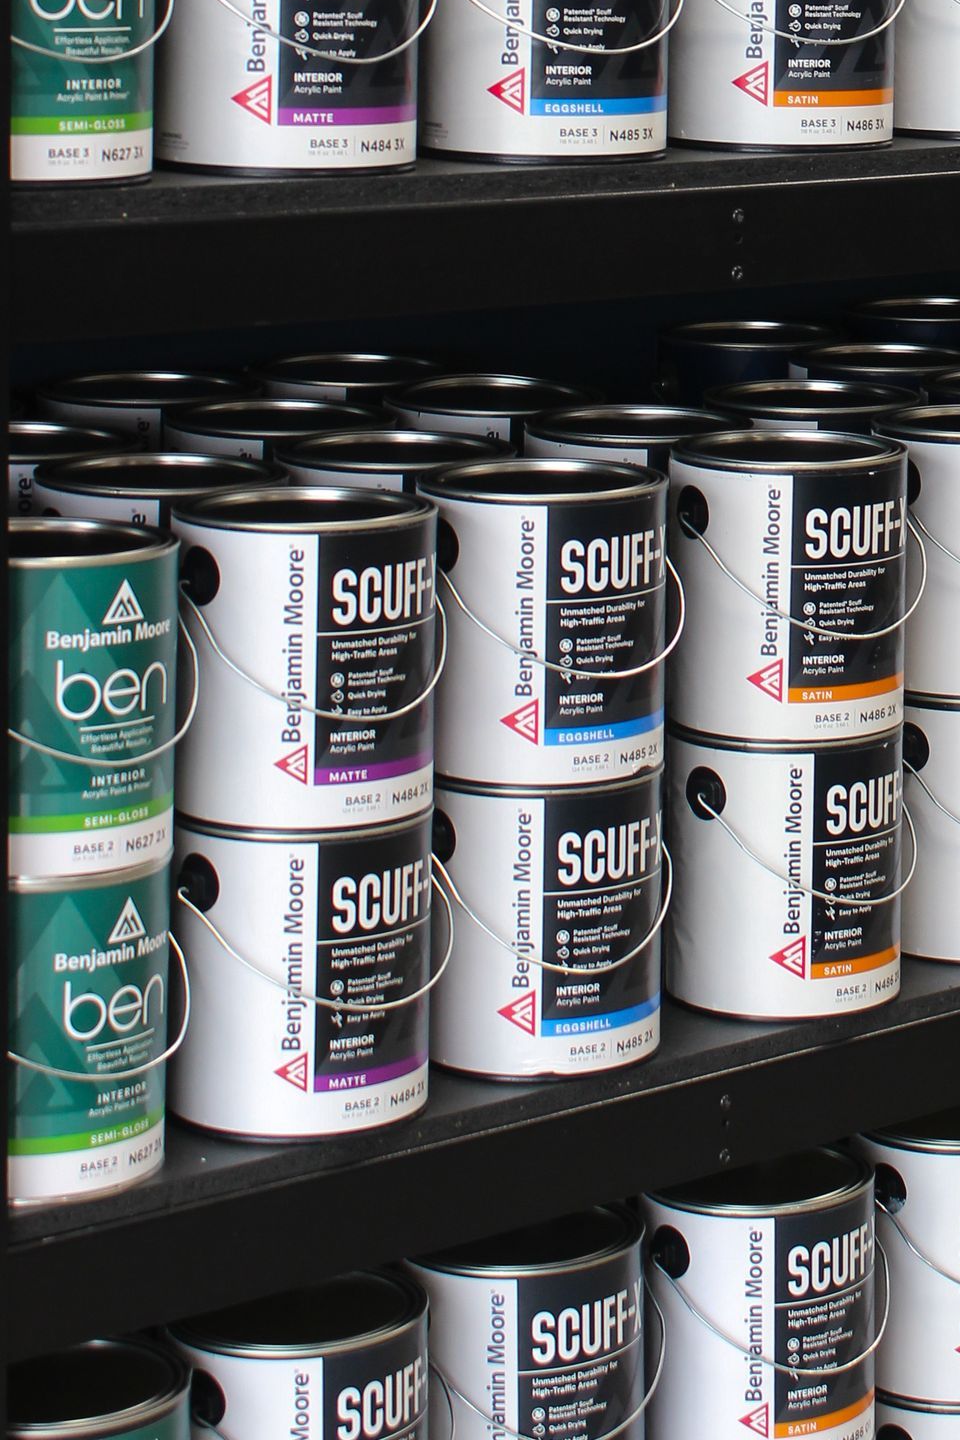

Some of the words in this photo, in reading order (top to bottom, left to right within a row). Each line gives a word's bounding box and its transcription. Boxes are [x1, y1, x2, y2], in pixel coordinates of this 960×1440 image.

[294, 72, 342, 83] INTERIOR
[787, 95, 819, 105] SATIN
[545, 103, 603, 114] EGGSHELL
[59, 119, 126, 131] SEMI-GLOSS
[293, 113, 333, 124] MATTE
[609, 127, 640, 142] N485
[642, 127, 653, 141] 3X
[284, 548, 305, 625] Moore
[55, 660, 167, 721] ben
[281, 633, 305, 743] Benjamin
[559, 693, 603, 705] INTERIOR
[860, 709, 885, 724] N486
[887, 704, 897, 718] 2X
[559, 728, 615, 742] EGGSHELL
[329, 769, 368, 782] MATTE
[84, 806, 149, 828] SEMI-GLOSS
[824, 963, 852, 974] SATIN
[91, 1119, 149, 1144] SEMI-GLOSS
[531, 1275, 642, 1366] SCUFF-X
[788, 1420, 817, 1434] SATIN
